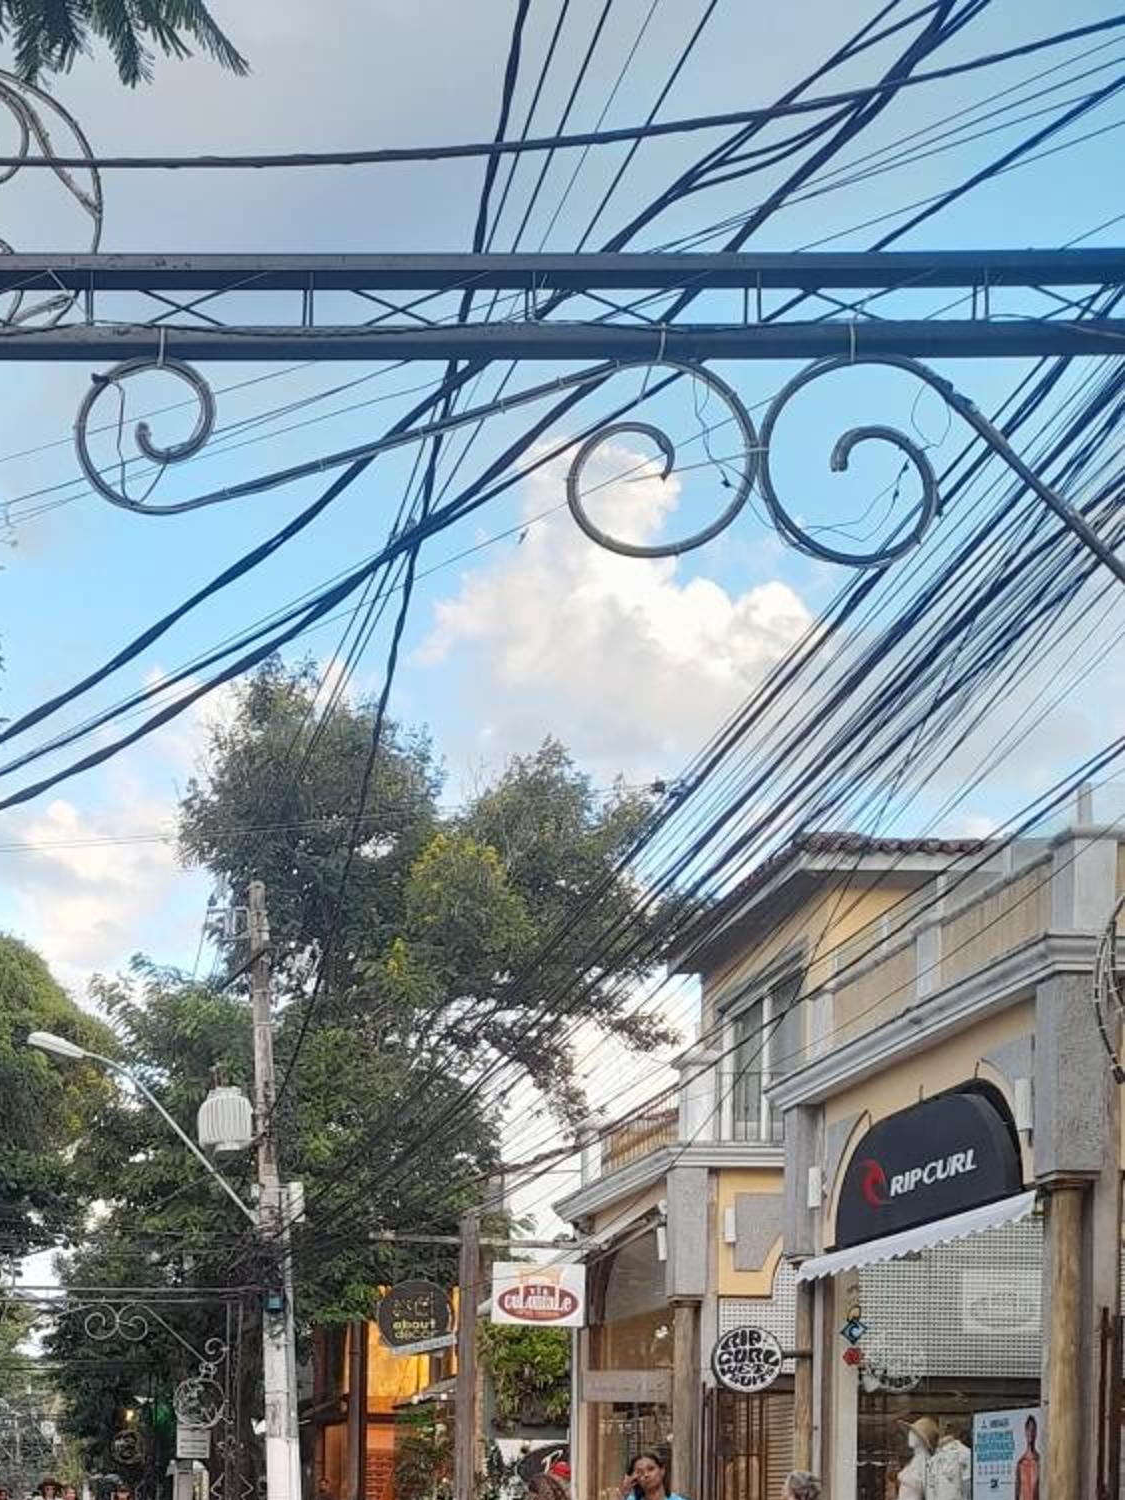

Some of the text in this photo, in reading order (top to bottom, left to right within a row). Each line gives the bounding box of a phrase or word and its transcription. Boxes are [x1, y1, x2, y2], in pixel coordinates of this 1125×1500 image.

[392, 1318, 436, 1329] about
[720, 1330, 762, 1350] RIP
[718, 1347, 780, 1367] CURL
